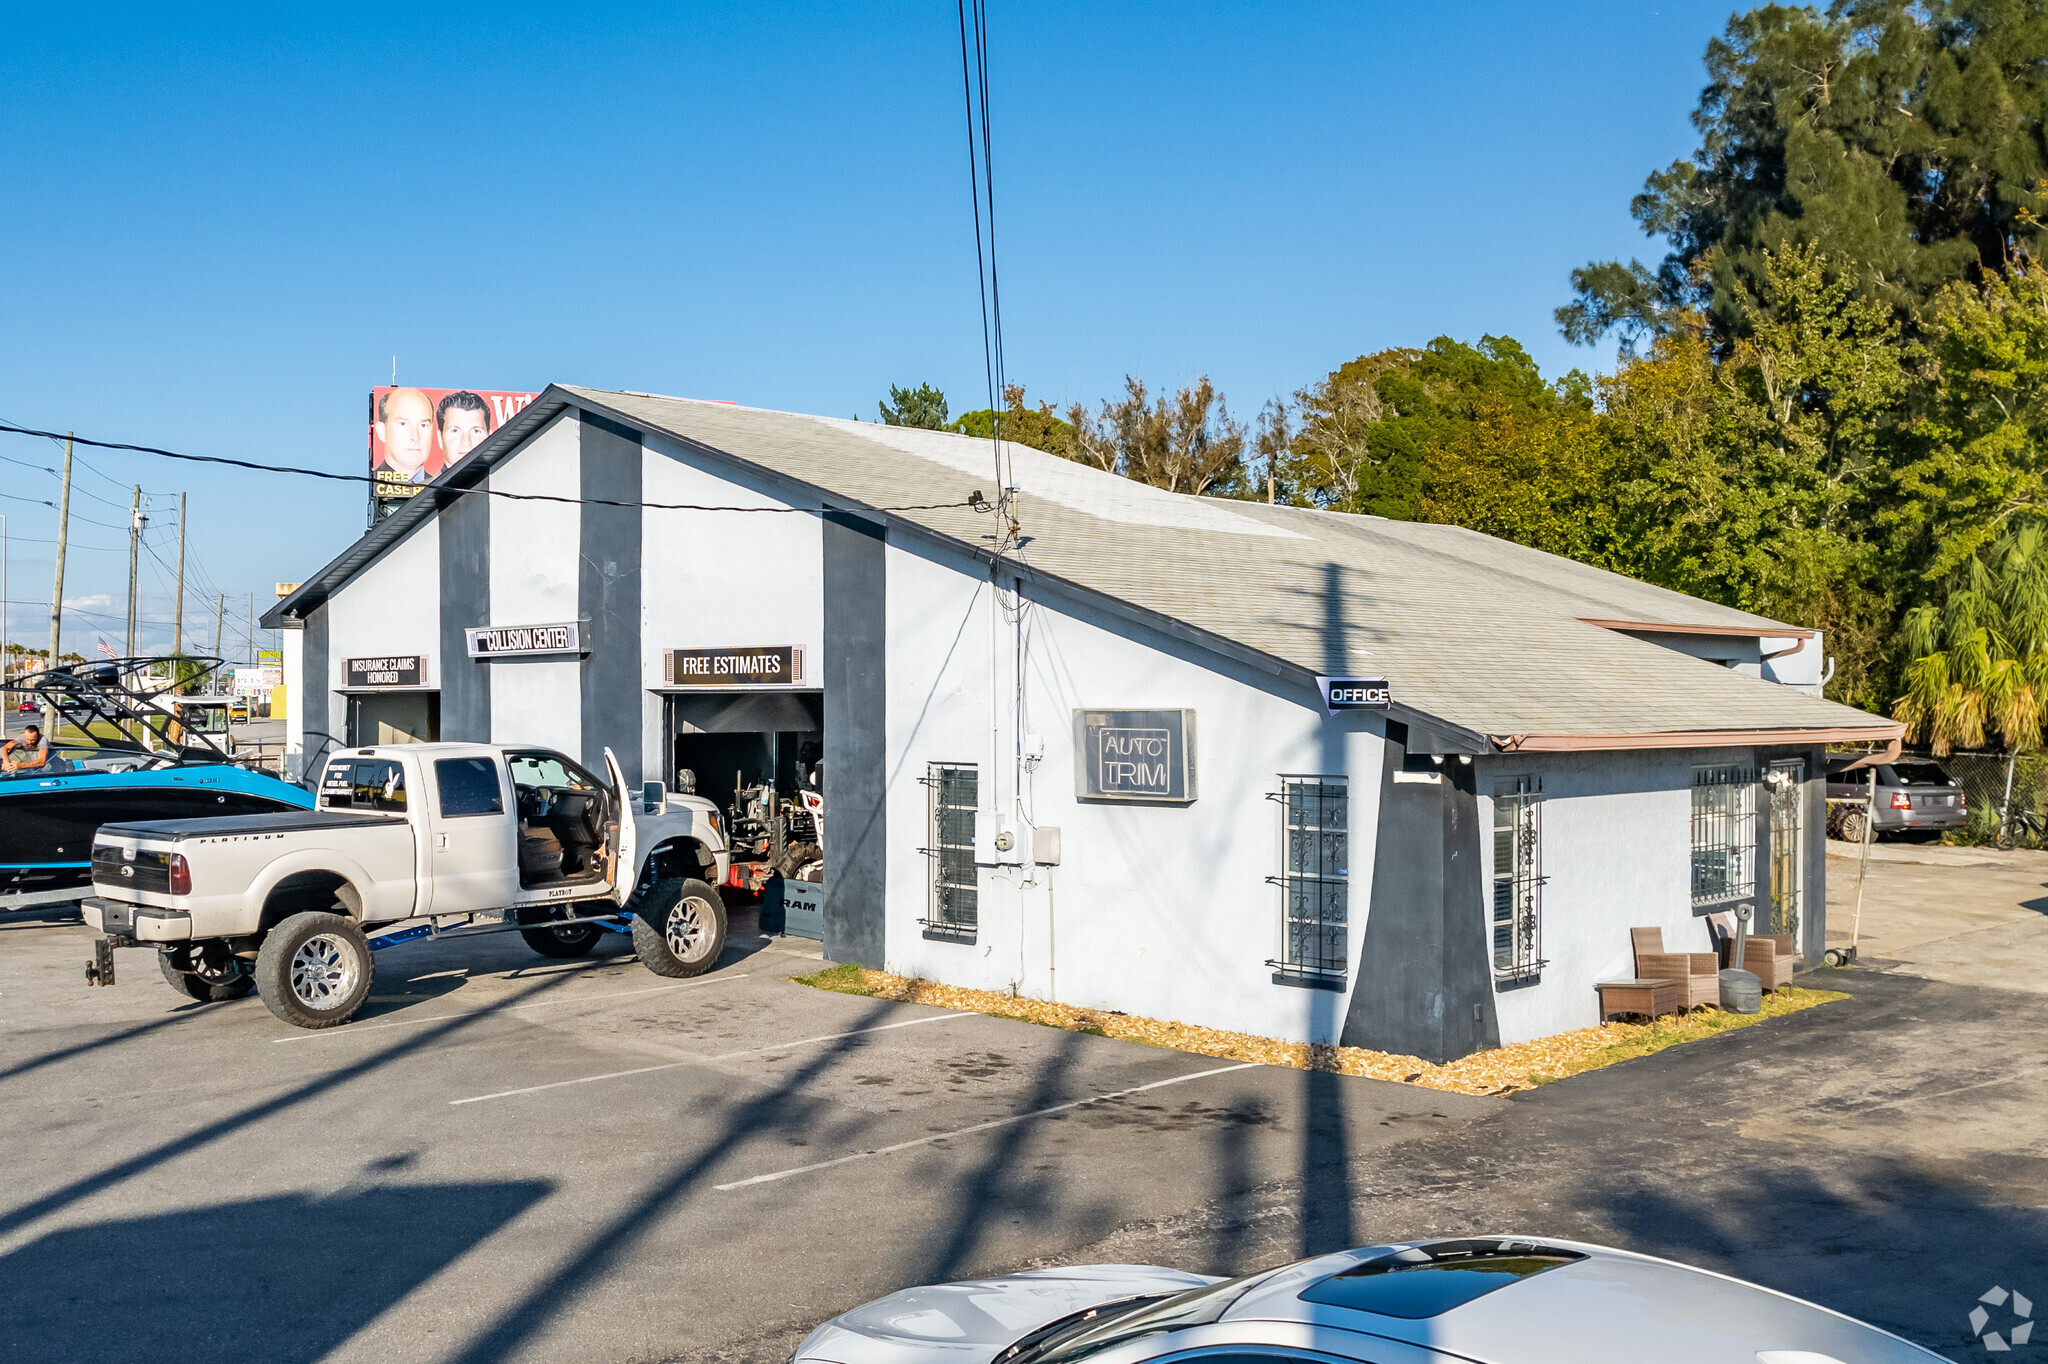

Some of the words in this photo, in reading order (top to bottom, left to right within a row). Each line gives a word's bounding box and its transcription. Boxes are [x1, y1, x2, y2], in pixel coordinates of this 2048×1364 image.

[376, 471, 409, 483] FREE
[376, 484, 410, 496] CASE
[487, 629, 532, 652] COLLISION
[532, 627, 569, 649] CENTER
[351, 659, 389, 672] INSURANCE
[389, 658, 415, 671] CLAIMS
[683, 656, 711, 675] FREE
[714, 654, 781, 675] ESTIMATES
[367, 671, 398, 684] HONORED
[236, 688, 261, 696] COPIES
[1330, 688, 1389, 702] OFFICE
[1105, 736, 1167, 757] AUTO
[1104, 761, 1167, 787] TRIM
[200, 833, 285, 844] PLATINUM
[548, 889, 572, 897] PLAYBOY
[779, 898, 817, 912] RAM
